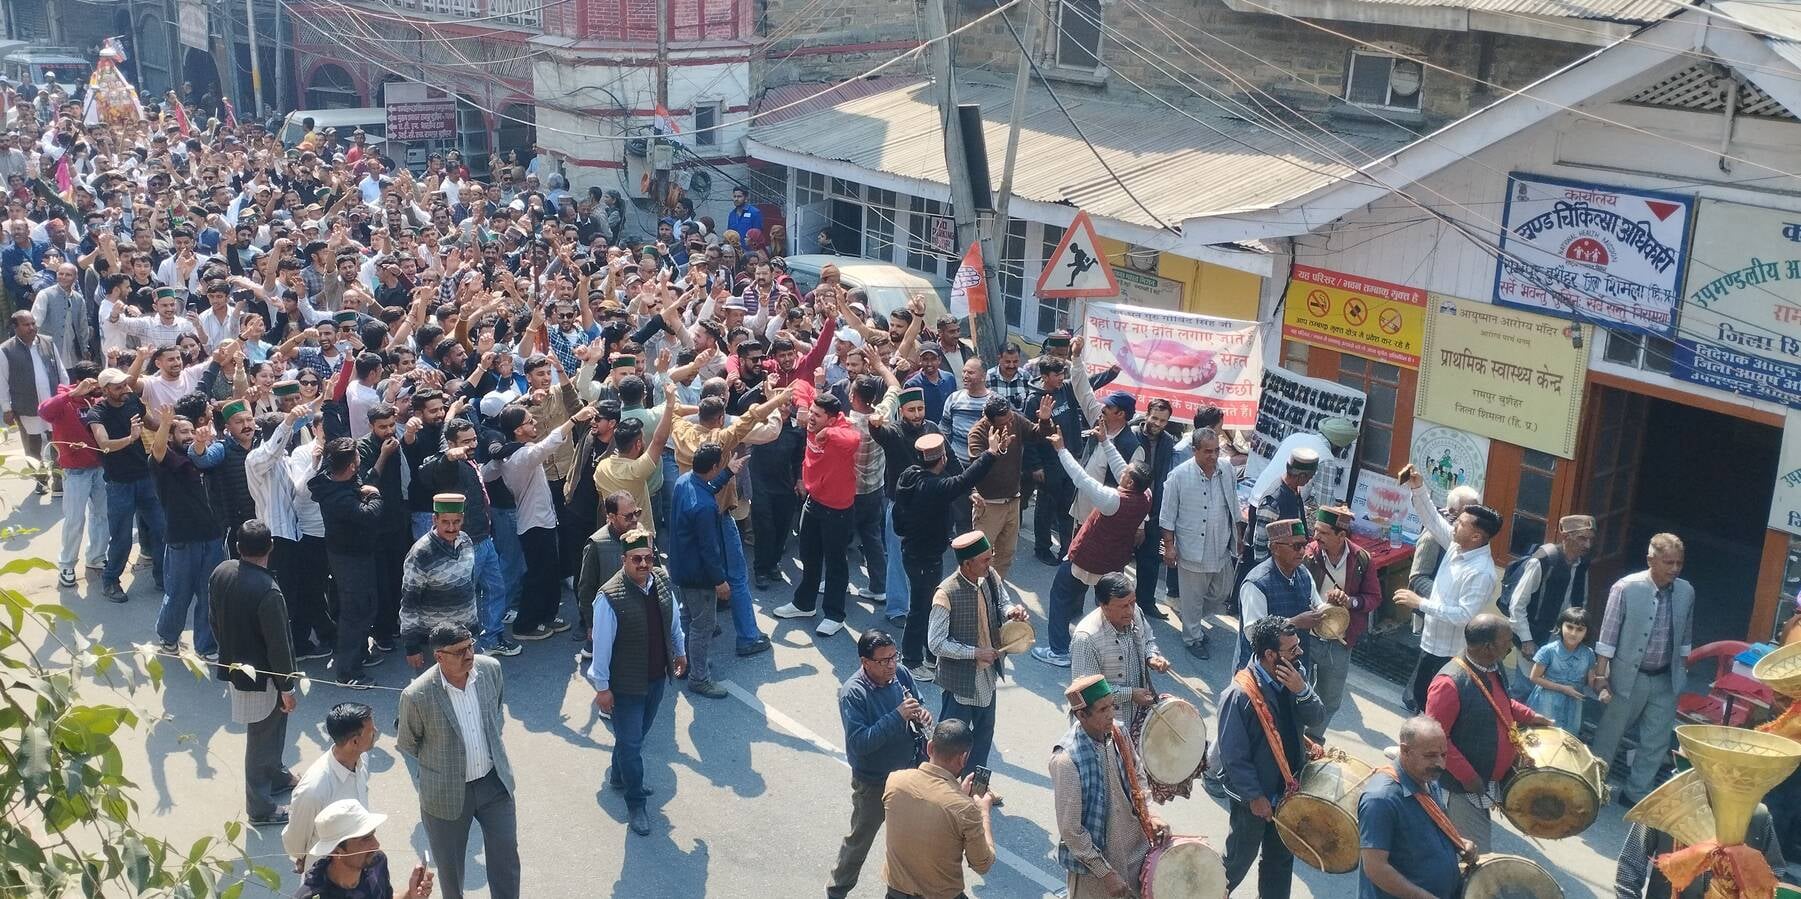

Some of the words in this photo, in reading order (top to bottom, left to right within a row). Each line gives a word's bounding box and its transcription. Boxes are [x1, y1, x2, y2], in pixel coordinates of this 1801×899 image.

[1564, 188, 1619, 207] कार्यालय
[1553, 200, 1621, 235] चिकित्सा
[1616, 220, 1676, 275] अधिकारी
[1690, 257, 1781, 309] उपमण्डलीय
[1112, 319, 1129, 332] पर
[1460, 308, 1498, 323] आयुष्मान
[1500, 316, 1534, 331] आरोग्य
[1718, 321, 1774, 351] जिला
[1220, 347, 1249, 368] सेहत
[1440, 347, 1488, 376] प्राथमिक
[1491, 359, 1533, 385] स्वास्थ्य
[1537, 364, 1564, 395] केन्द्र
[1214, 379, 1254, 396] अच्छी
[1472, 388, 1497, 404] रामपुर
[1454, 402, 1475, 416] जिला
[1478, 408, 1505, 425] शिमला
